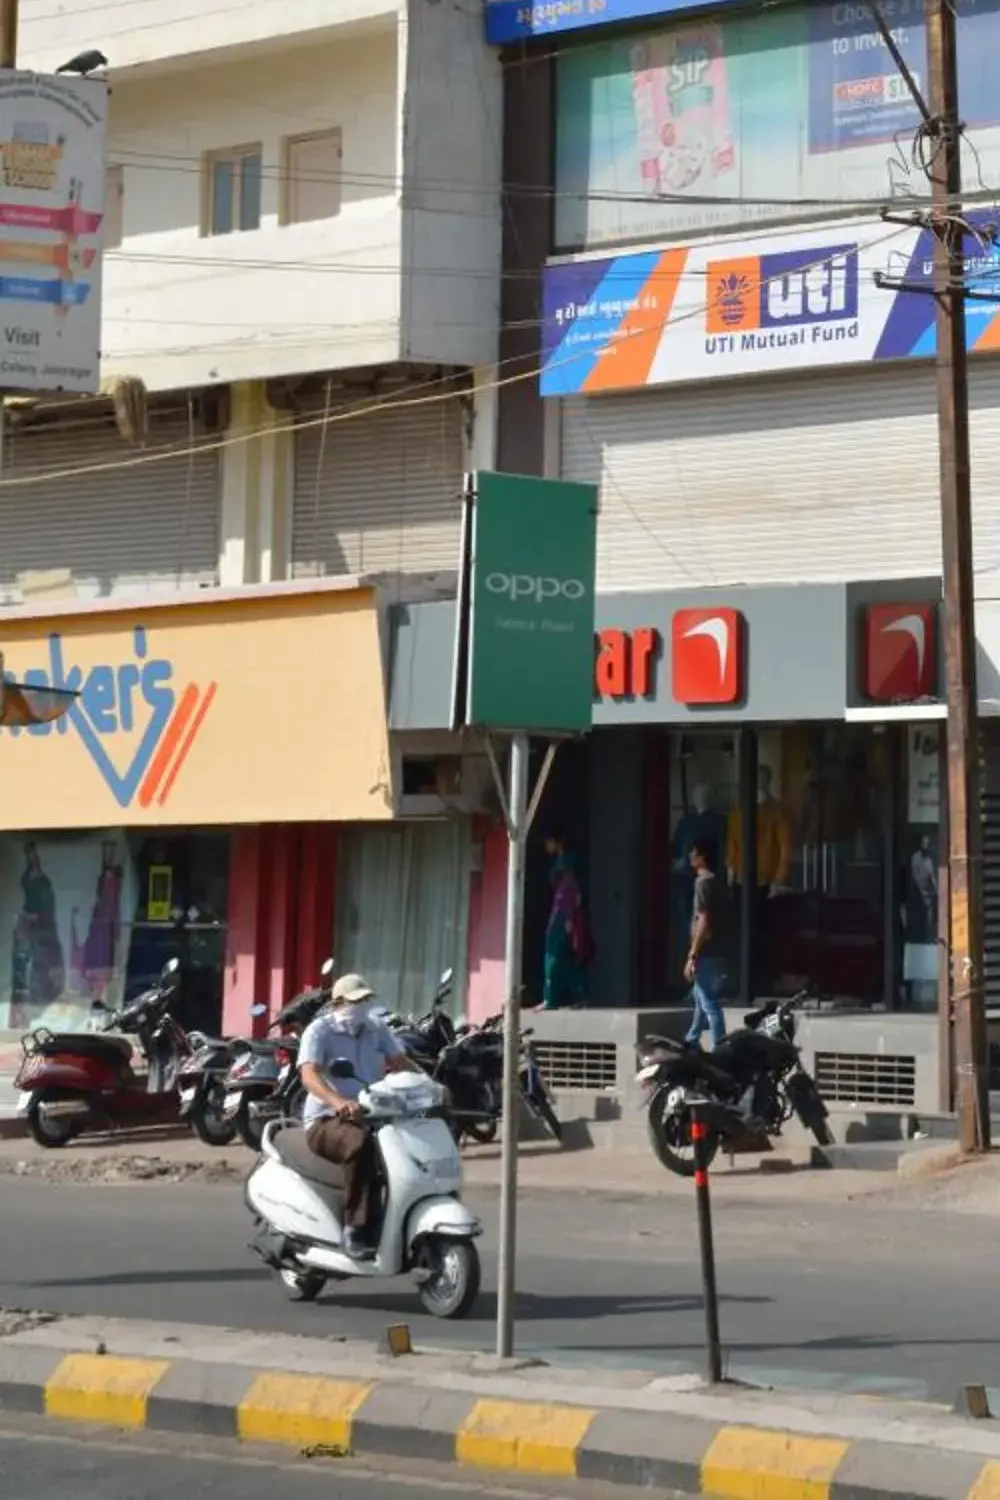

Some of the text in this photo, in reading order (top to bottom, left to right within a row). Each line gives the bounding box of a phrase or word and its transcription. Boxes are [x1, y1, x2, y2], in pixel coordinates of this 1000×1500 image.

[832, 37, 850, 56] to
[668, 56, 710, 94] SIP
[767, 253, 848, 320] uti
[5, 326, 41, 347] Visit
[705, 321, 860, 356] UTI Mutual Fund
